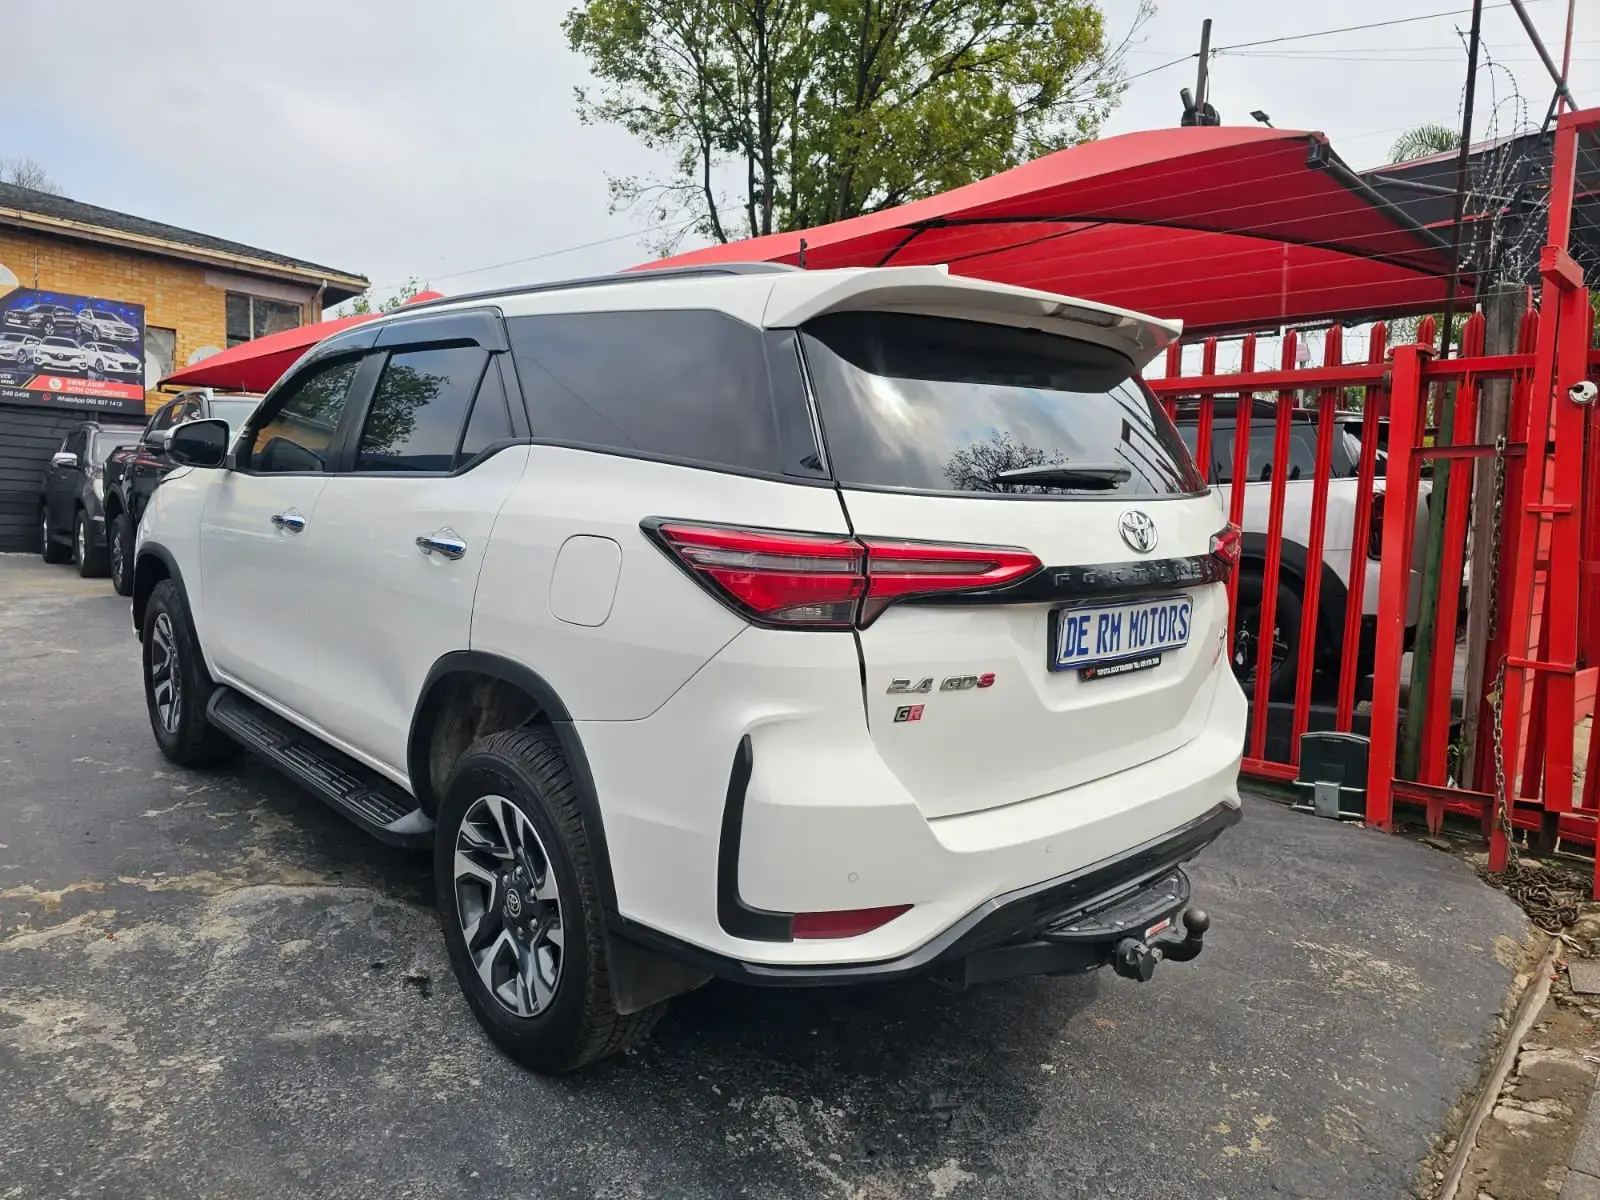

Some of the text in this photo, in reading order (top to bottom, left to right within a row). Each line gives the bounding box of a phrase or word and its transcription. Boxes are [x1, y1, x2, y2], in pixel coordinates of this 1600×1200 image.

[56, 395, 86, 404] WhatsApp
[1063, 603, 1190, 658] DE RM MOTORS
[893, 704, 926, 722] GR
